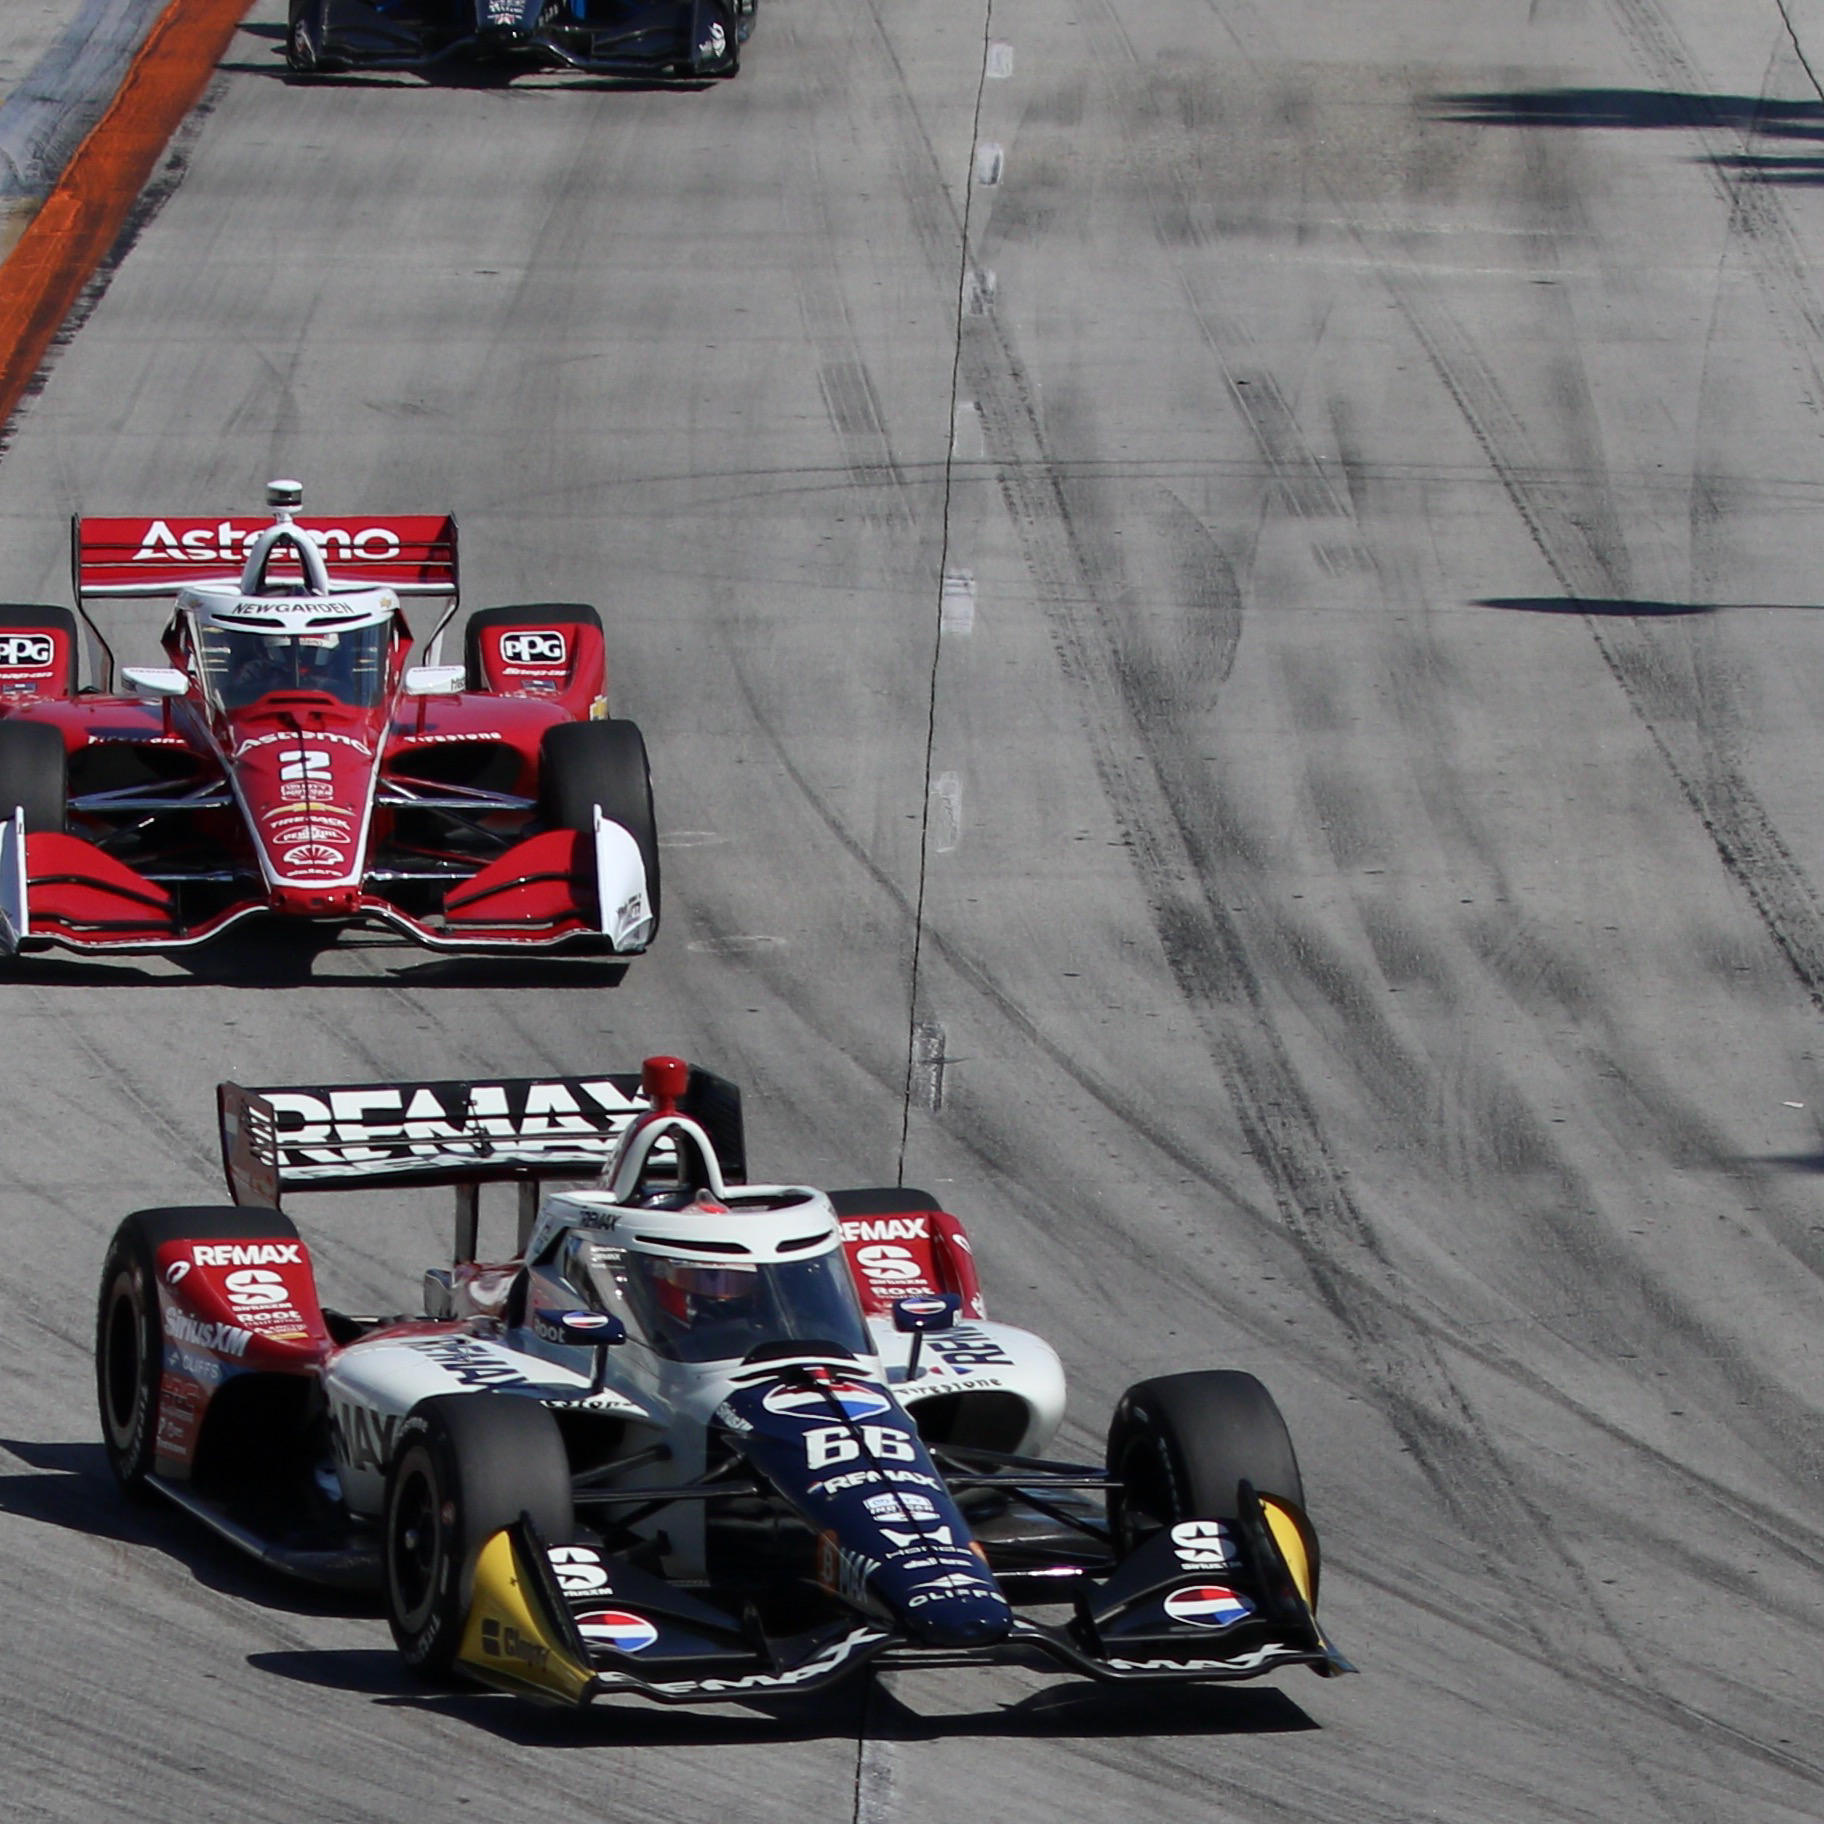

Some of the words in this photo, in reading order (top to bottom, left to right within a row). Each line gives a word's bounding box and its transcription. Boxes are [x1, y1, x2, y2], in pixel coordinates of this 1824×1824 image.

[232, 601, 355, 617] NEWGARDEN
[503, 635, 562, 662] PPG
[279, 750, 333, 781] 2
[192, 1244, 303, 1267] REMAX
[164, 1306, 254, 1358] SiriusXM
[802, 1425, 916, 1471] 66
[823, 1469, 942, 1495] REMAX
